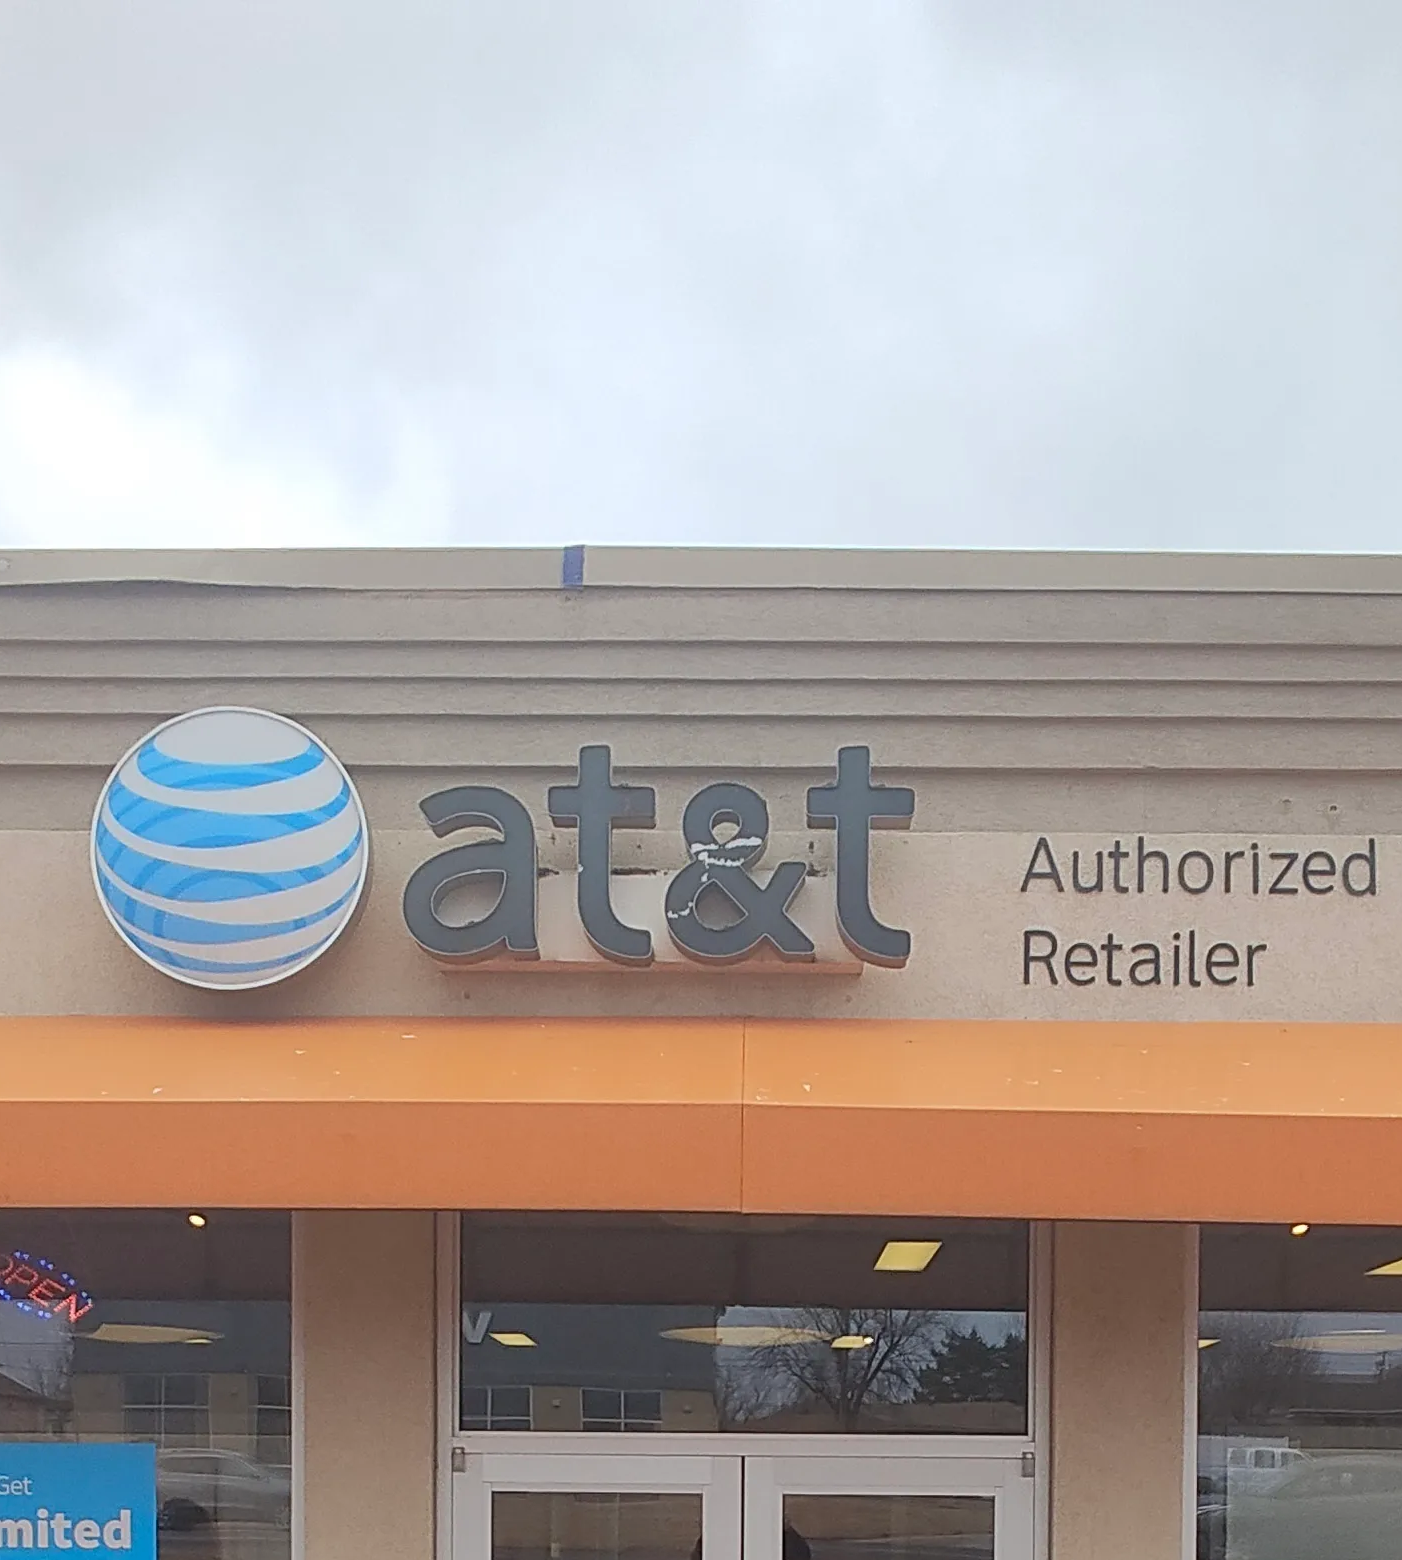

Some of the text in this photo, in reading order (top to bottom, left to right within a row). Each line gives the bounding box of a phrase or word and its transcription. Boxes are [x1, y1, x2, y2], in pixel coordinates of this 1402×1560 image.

[402, 744, 915, 966] at&t
[1020, 836, 1377, 896] Authorized
[1023, 929, 1268, 987] Retailer
